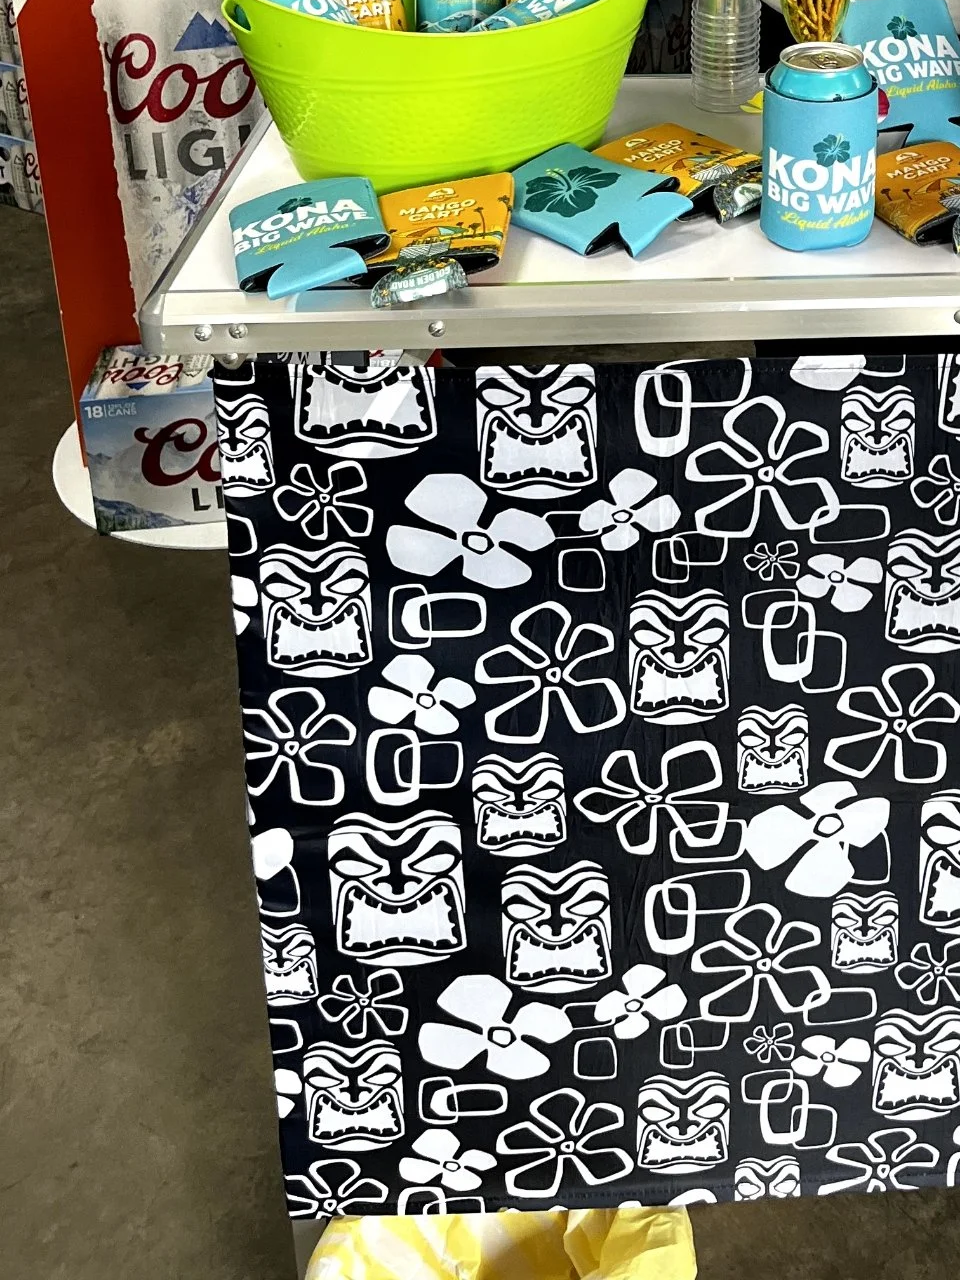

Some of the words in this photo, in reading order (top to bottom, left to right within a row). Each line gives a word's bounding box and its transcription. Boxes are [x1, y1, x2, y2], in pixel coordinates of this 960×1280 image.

[349, 0, 393, 18] CART
[854, 33, 958, 69] KONA
[886, 78, 924, 98] Liquid
[927, 79, 959, 91] Aloha
[624, 139, 682, 164] MANGO
[642, 146, 684, 163] CART
[769, 147, 876, 194] KONA
[887, 156, 951, 179] MANGO
[903, 164, 949, 181] CART
[768, 180, 809, 212] BIG
[400, 198, 476, 217] MANGO
[408, 207, 463, 222] CART
[234, 199, 366, 245] KONA
[780, 211, 832, 231] Liquid
[235, 232, 280, 254] BIG
[287, 210, 374, 233] WAVE
[255, 234, 306, 255] Liquid
[306, 223, 349, 238] Aloha
[391, 278, 421, 292] ROAD
[85, 406, 103, 418] 18
[108, 408, 137, 417] CANS
